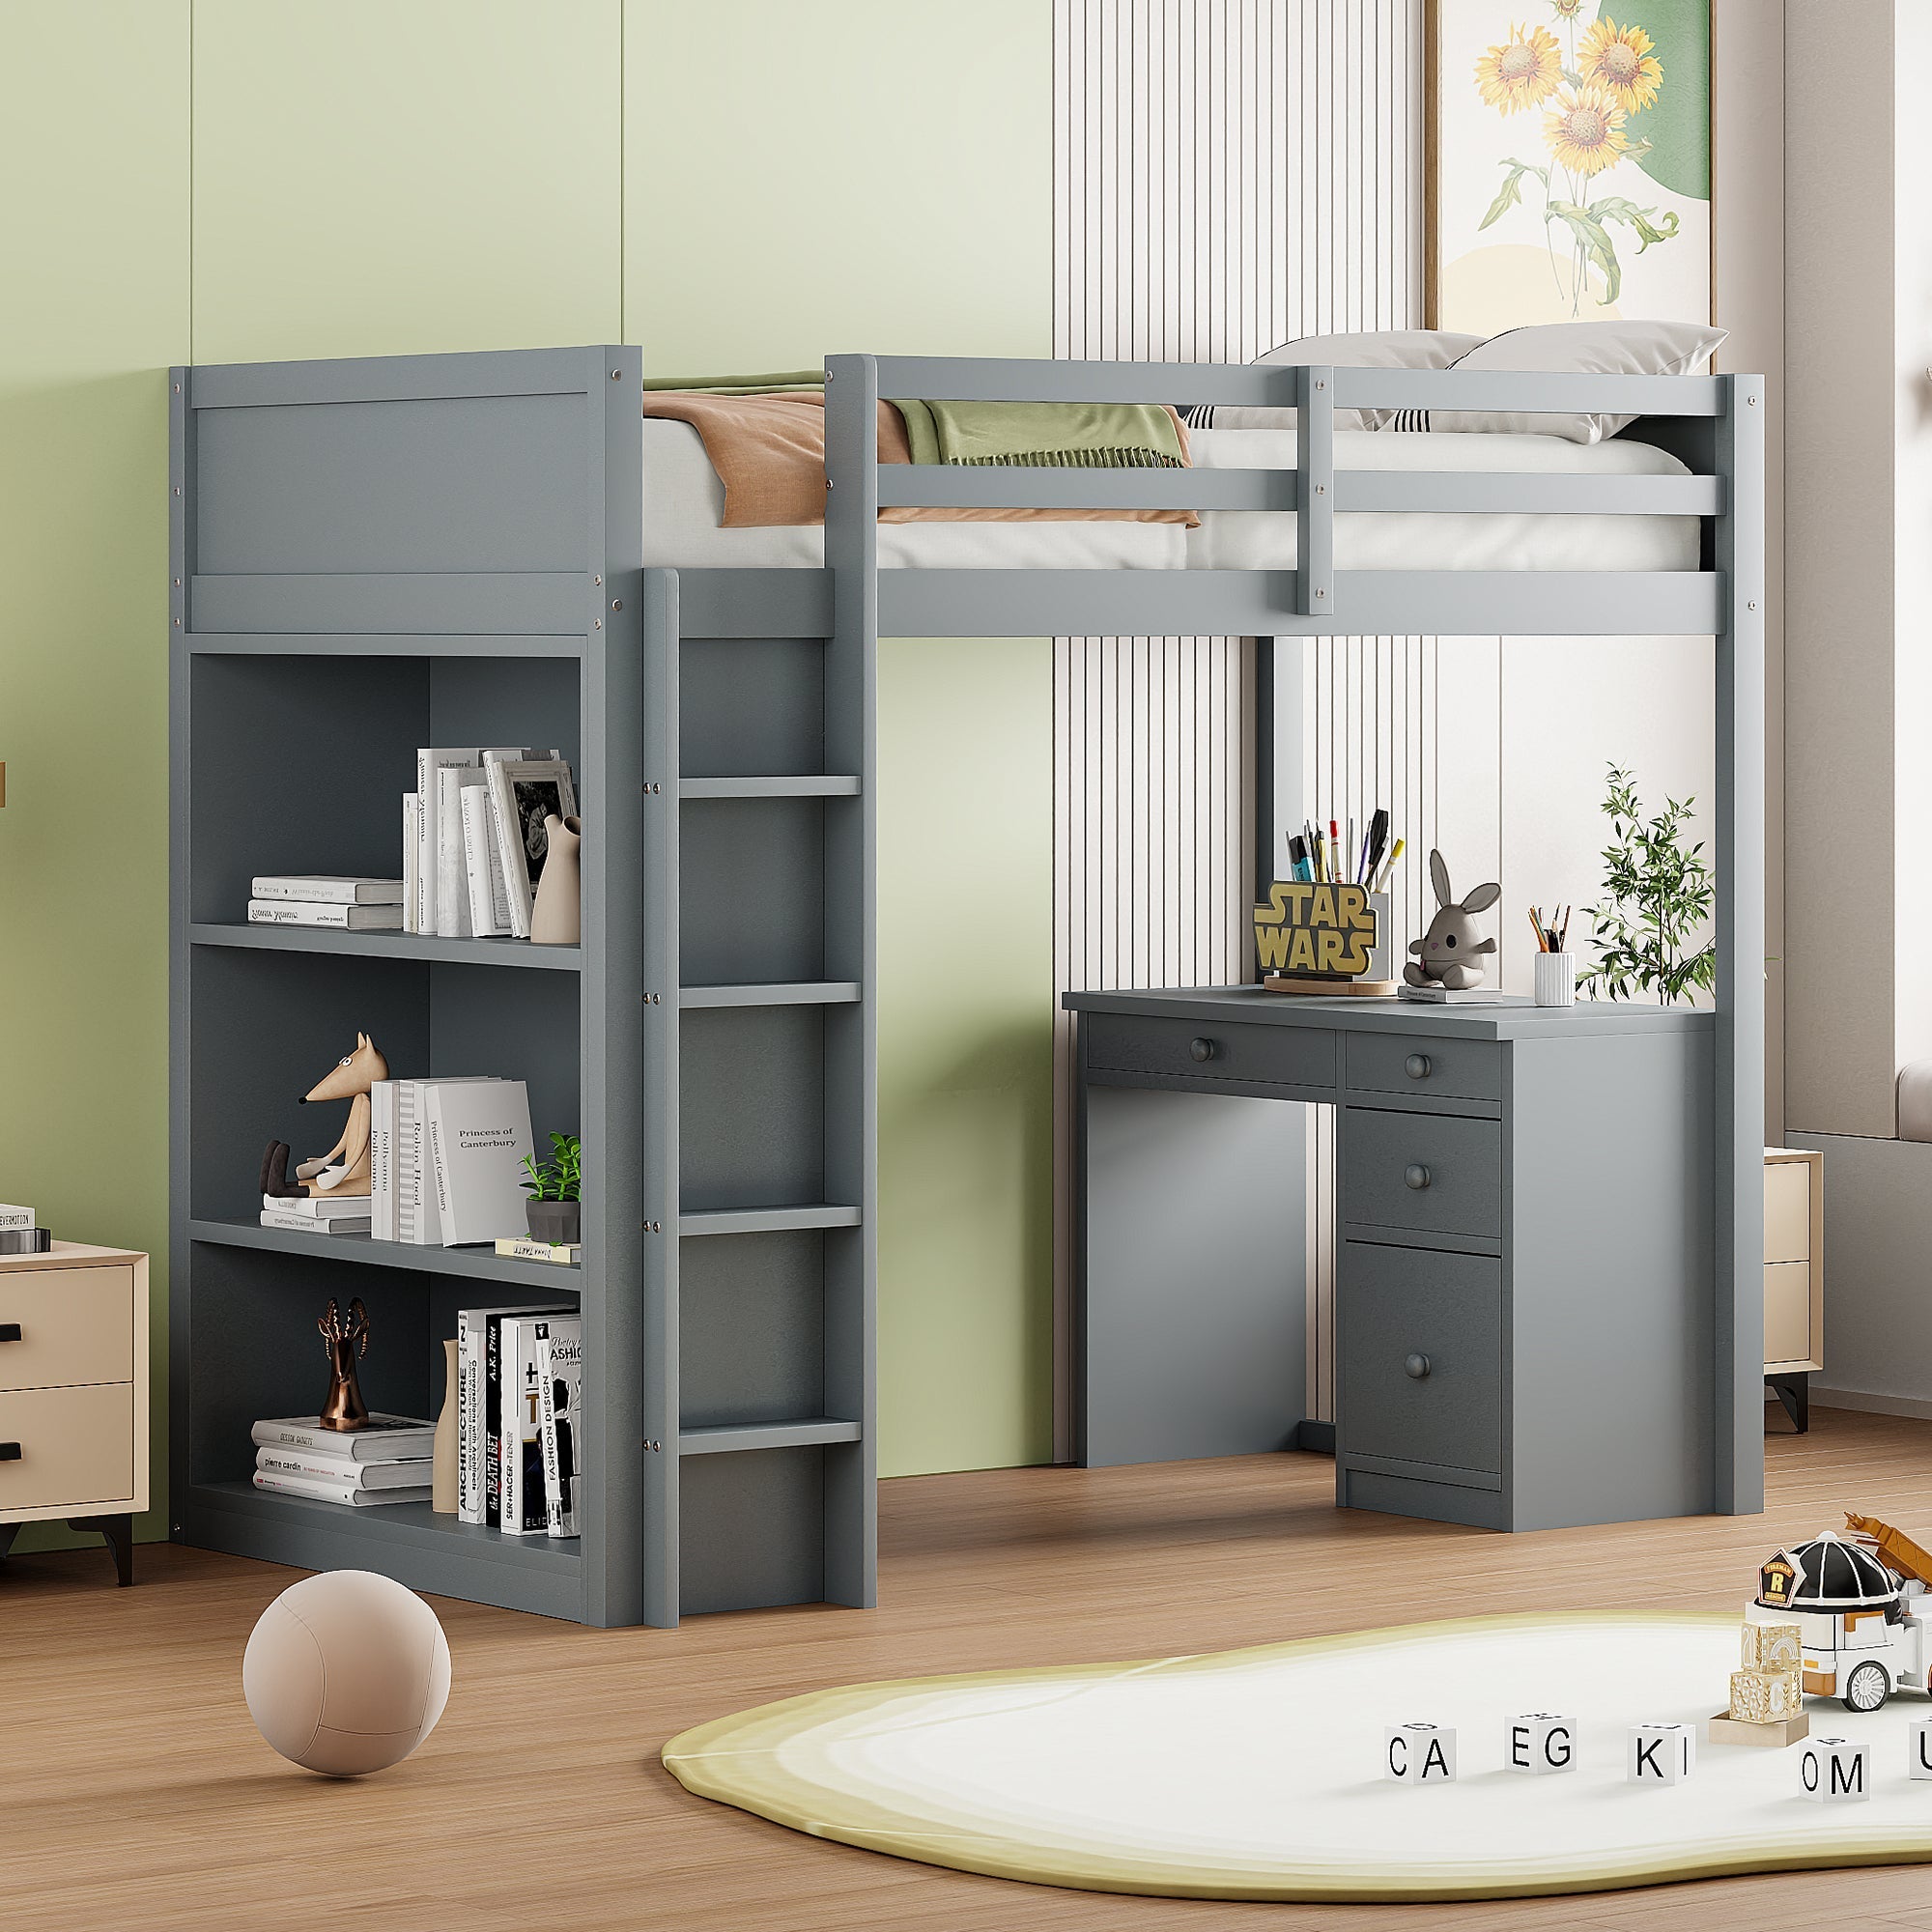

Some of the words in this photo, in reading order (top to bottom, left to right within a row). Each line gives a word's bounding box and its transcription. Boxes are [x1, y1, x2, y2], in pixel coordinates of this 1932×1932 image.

[1254, 884, 1374, 929] STAR
[1255, 927, 1374, 974] WARS
[431, 1121, 440, 1155] Princess
[435, 1156, 441, 1165] of
[437, 1166, 447, 1212] Canterbury
[543, 1376, 553, 1422] DESIGN
[487, 1432, 498, 1457] BET
[546, 1426, 556, 1481] FASHION
[265, 1458, 282, 1468] pierre
[282, 1461, 301, 1471] cardin
[487, 1457, 498, 1495] DEATH
[1771, 1573, 1784, 1592] R
